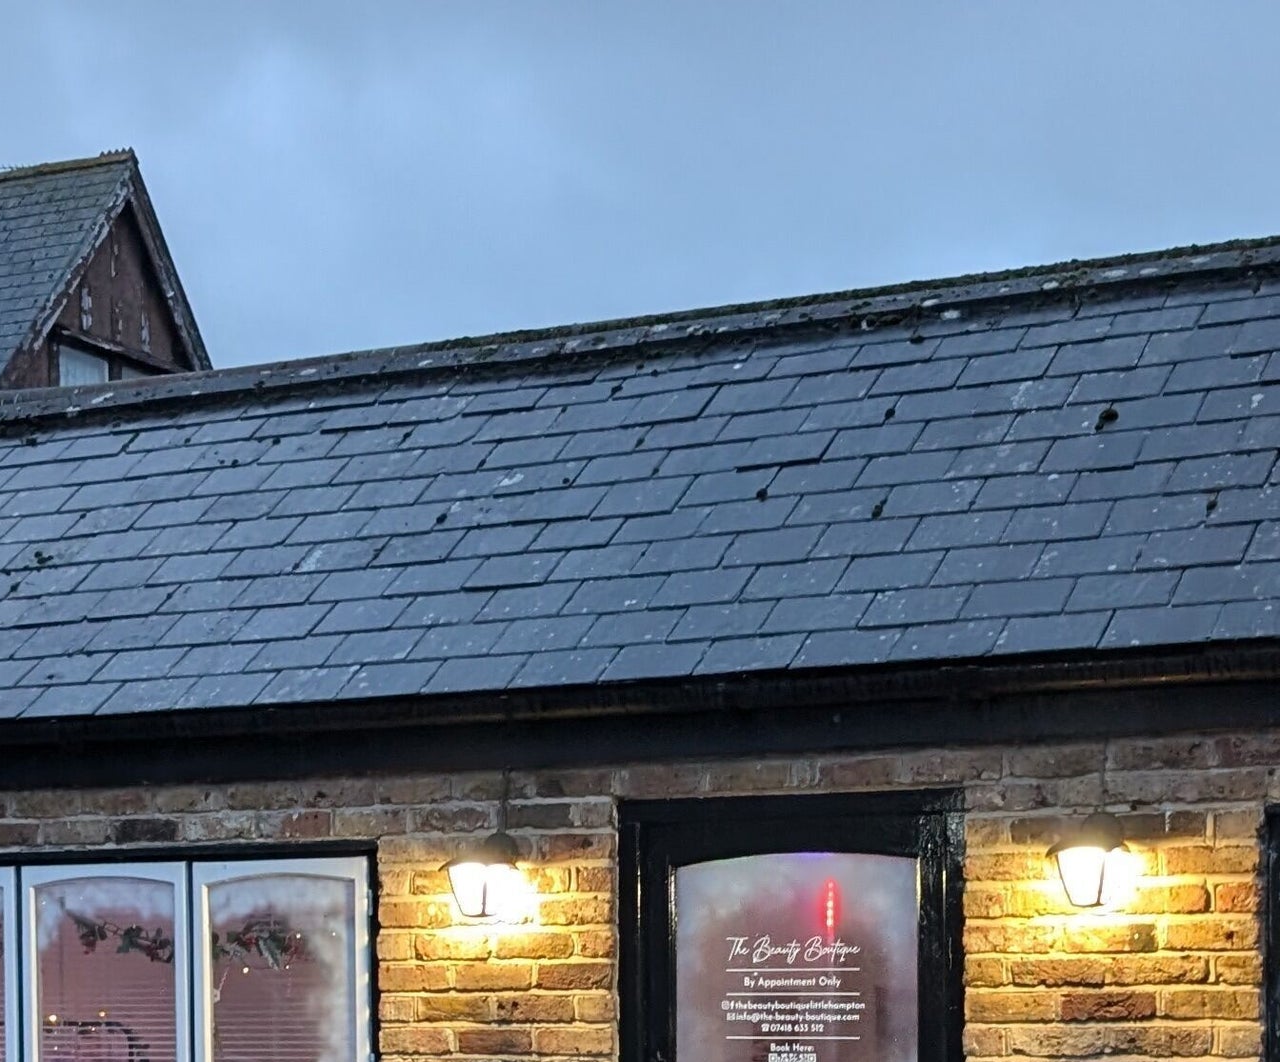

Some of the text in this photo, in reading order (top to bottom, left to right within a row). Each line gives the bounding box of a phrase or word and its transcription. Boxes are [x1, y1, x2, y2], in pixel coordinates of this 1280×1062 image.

[726, 934, 860, 964] The Beauty Boutique
[744, 975, 842, 988] By Appointment Only
[736, 1012, 860, 1023] info@the-beauty-boutique.com
[770, 1023, 793, 1033] 07418
[811, 1023, 825, 1033] 512
[770, 1042, 790, 1052] Book
